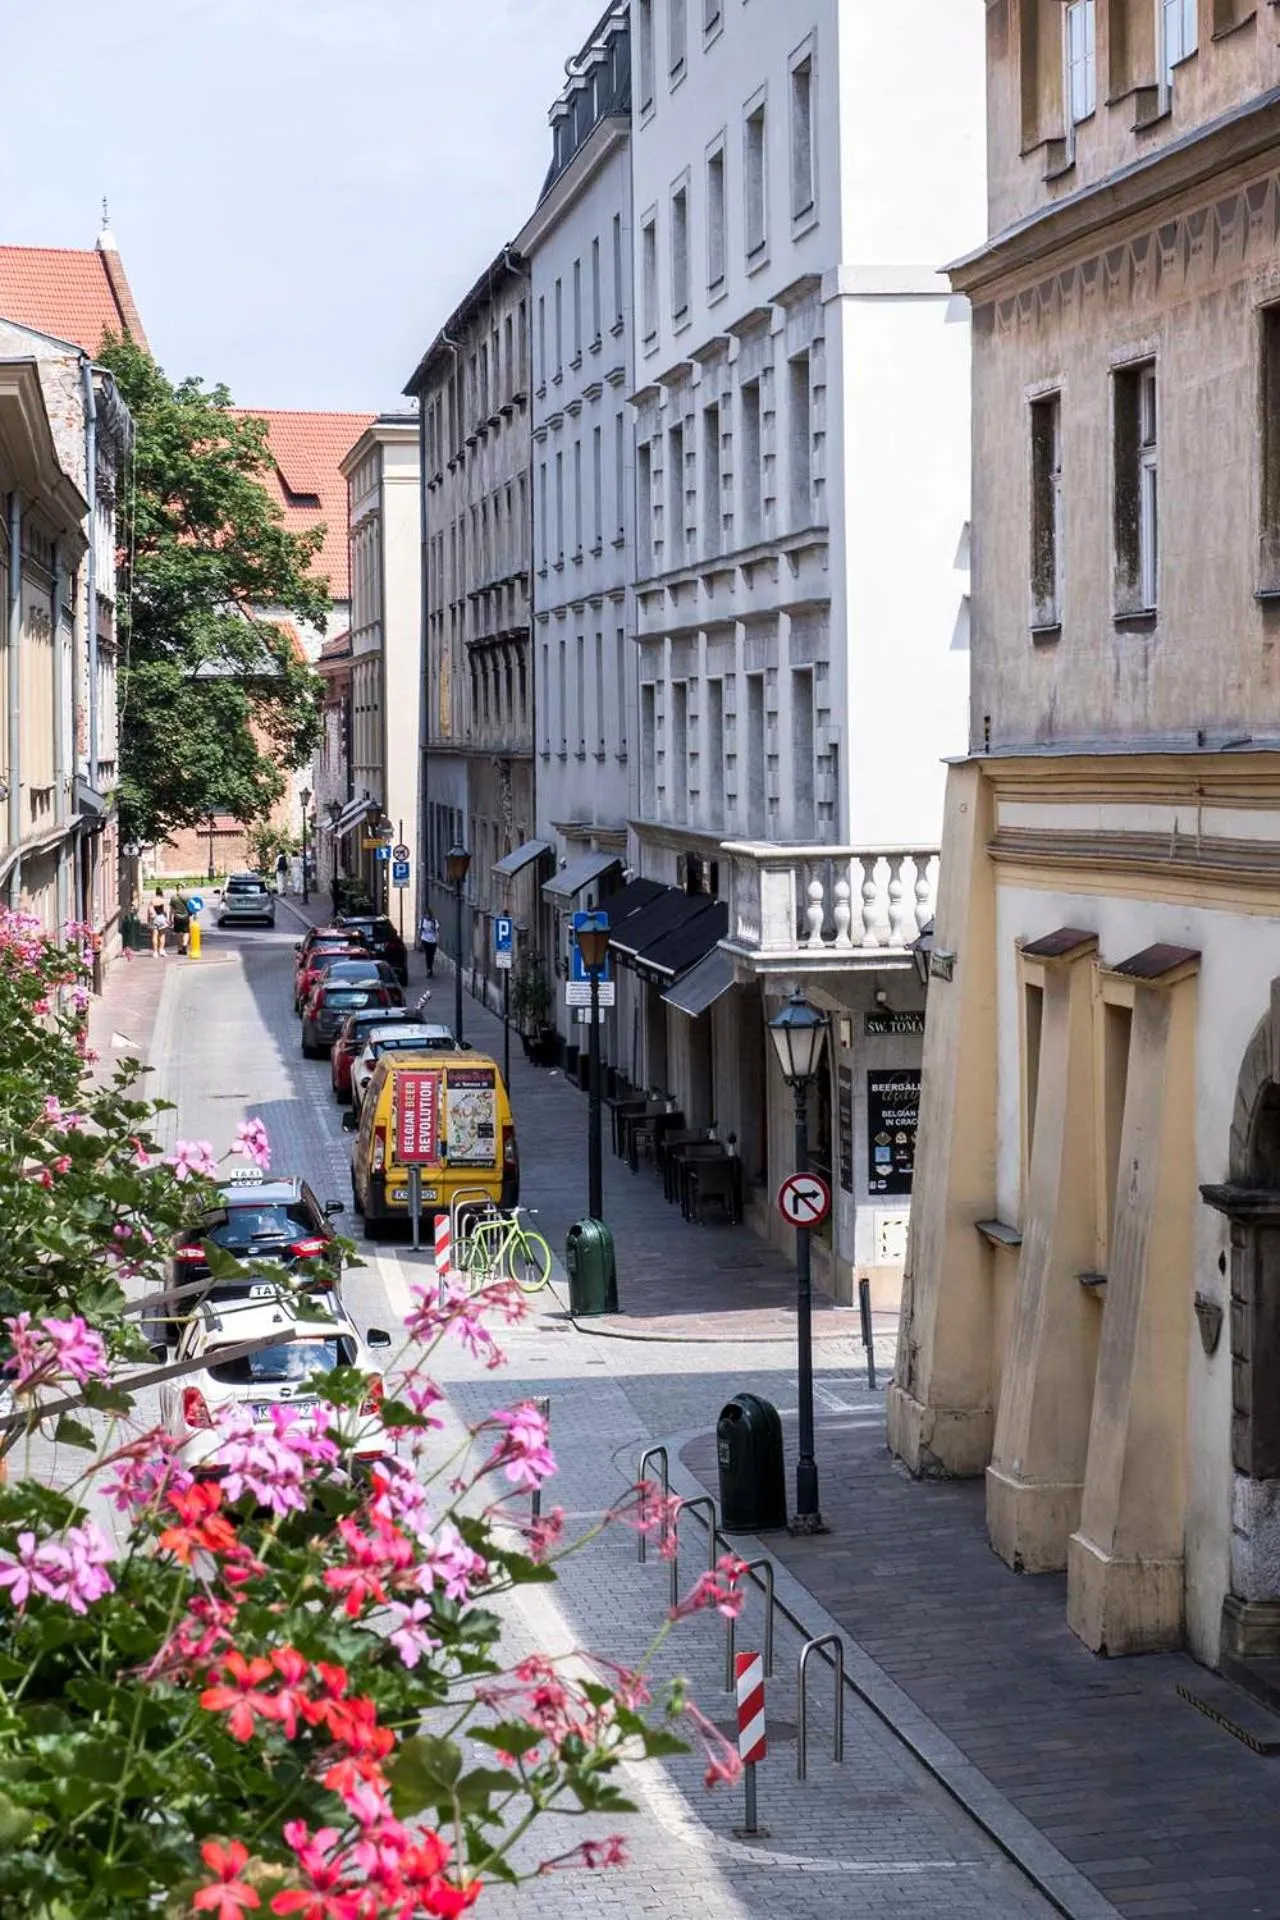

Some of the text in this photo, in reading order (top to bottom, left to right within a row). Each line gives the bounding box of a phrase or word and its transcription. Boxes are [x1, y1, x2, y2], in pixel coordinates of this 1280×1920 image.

[498, 921, 509, 941] P
[404, 1081, 416, 1153] BELGIAN BEER
[419, 1080, 433, 1153] REVOLUTION
[881, 1110, 916, 1118] BELGIAN
[885, 1118, 894, 1126] IN
